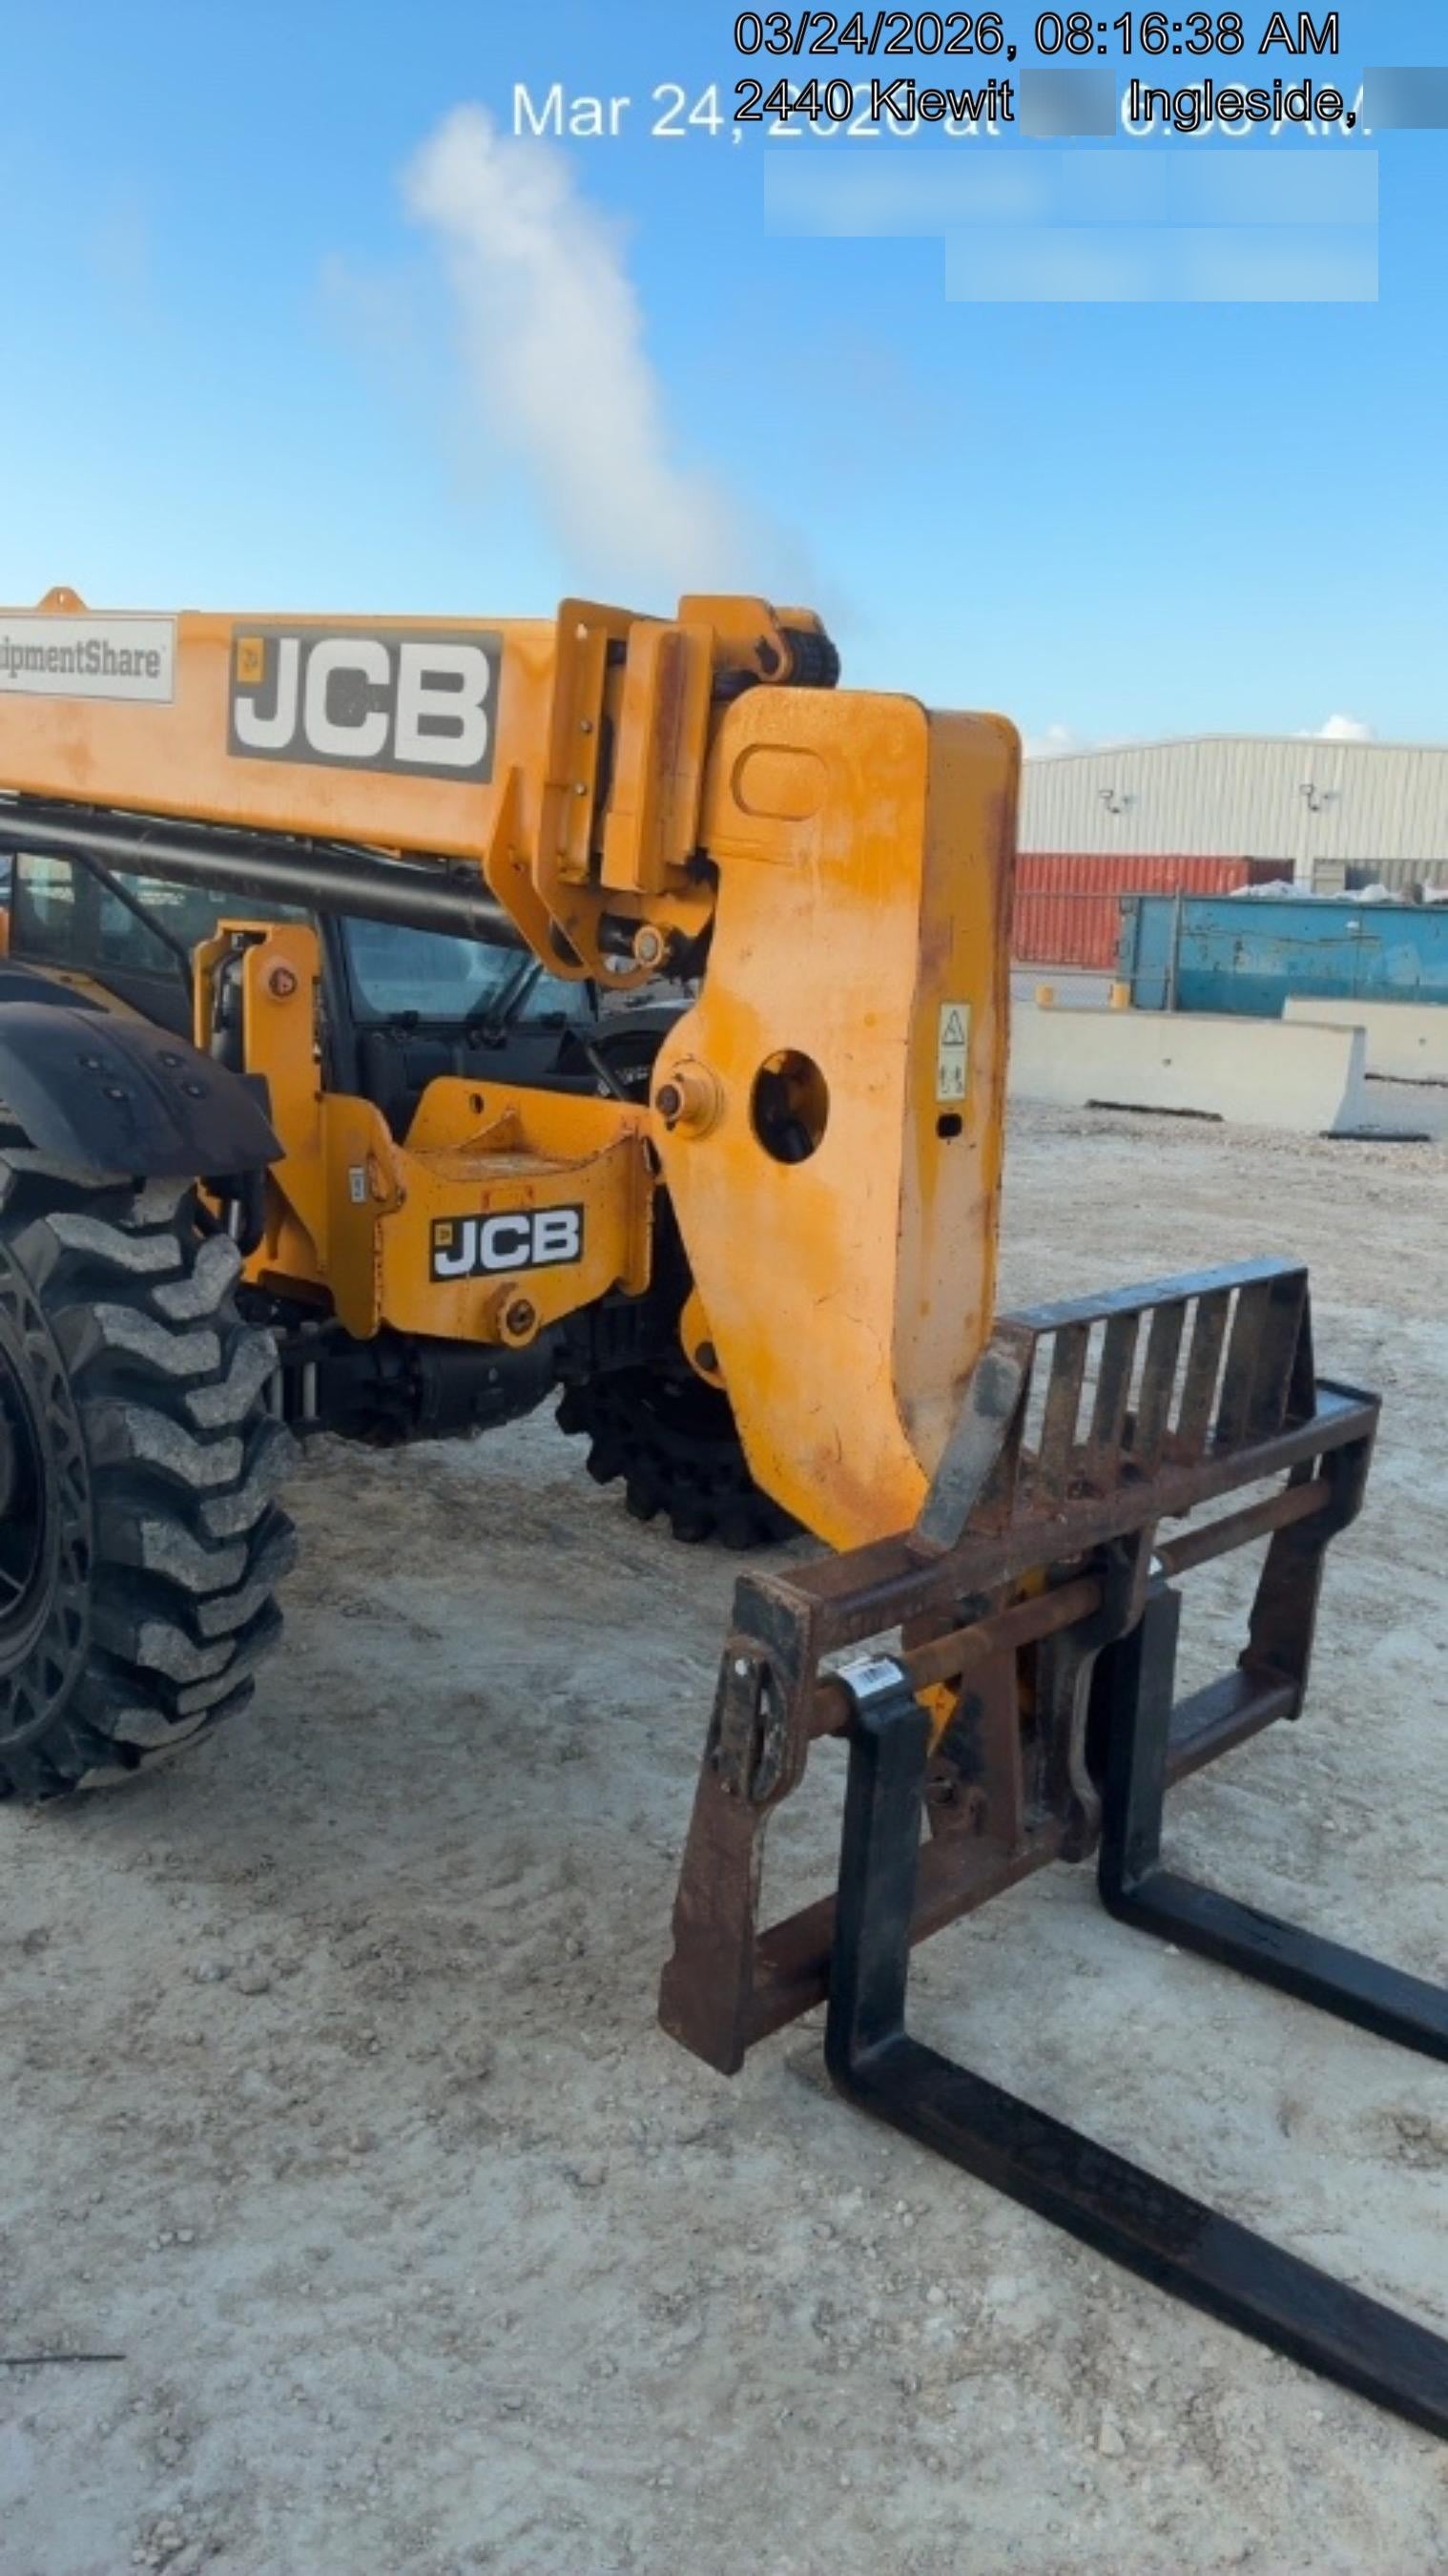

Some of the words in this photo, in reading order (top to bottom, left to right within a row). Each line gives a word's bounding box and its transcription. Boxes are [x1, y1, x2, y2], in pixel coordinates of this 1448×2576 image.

[0, 635, 160, 679] ipmentShare
[235, 637, 489, 767] JCB
[434, 1210, 579, 1275] JCB
